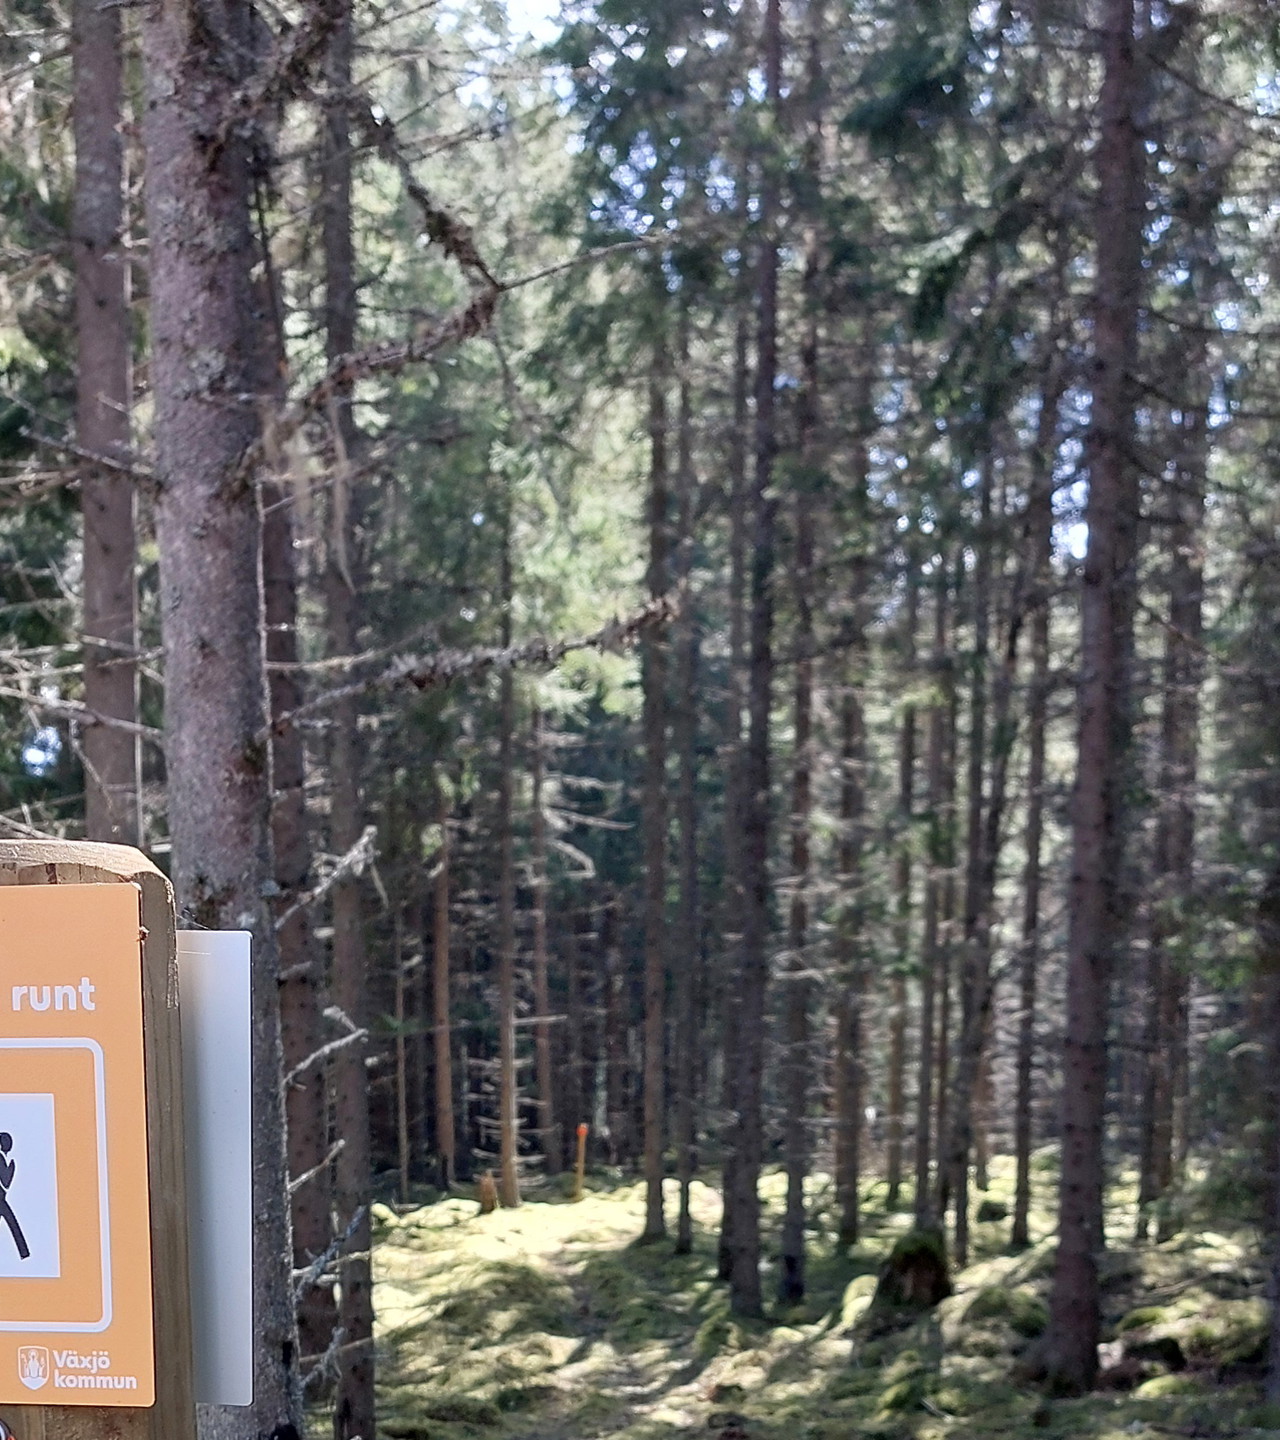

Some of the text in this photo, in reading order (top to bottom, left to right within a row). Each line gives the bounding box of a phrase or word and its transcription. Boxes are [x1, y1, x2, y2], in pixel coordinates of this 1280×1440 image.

[12, 976, 96, 1011] runt
[53, 1350, 110, 1373] Växjö
[55, 1371, 137, 1389] kommun
